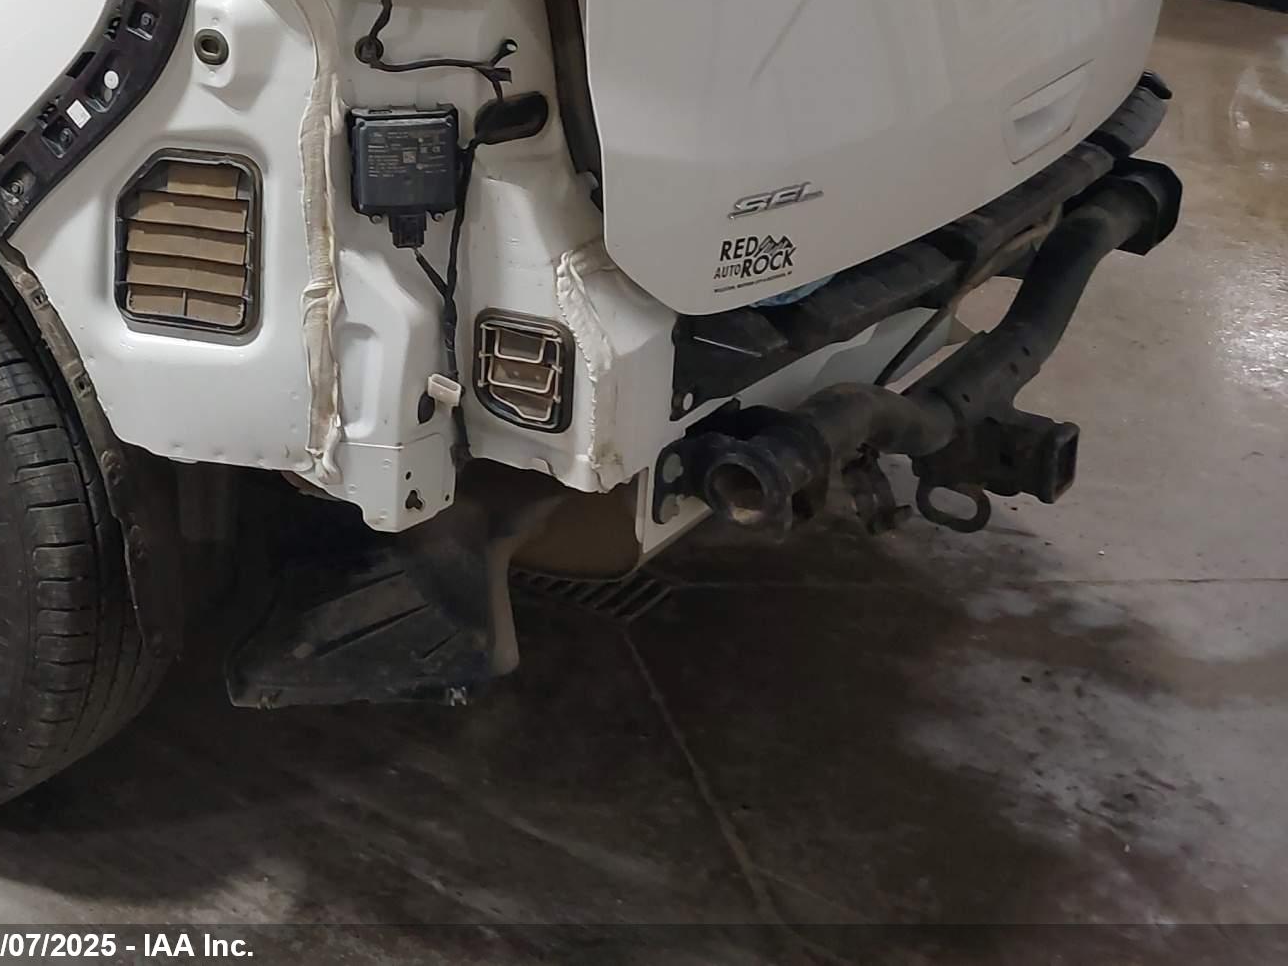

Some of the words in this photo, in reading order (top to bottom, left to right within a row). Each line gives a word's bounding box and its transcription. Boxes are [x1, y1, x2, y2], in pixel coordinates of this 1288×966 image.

[713, 263, 742, 280] AUTO
[740, 246, 797, 279] ROCK
[719, 236, 759, 262] RED
